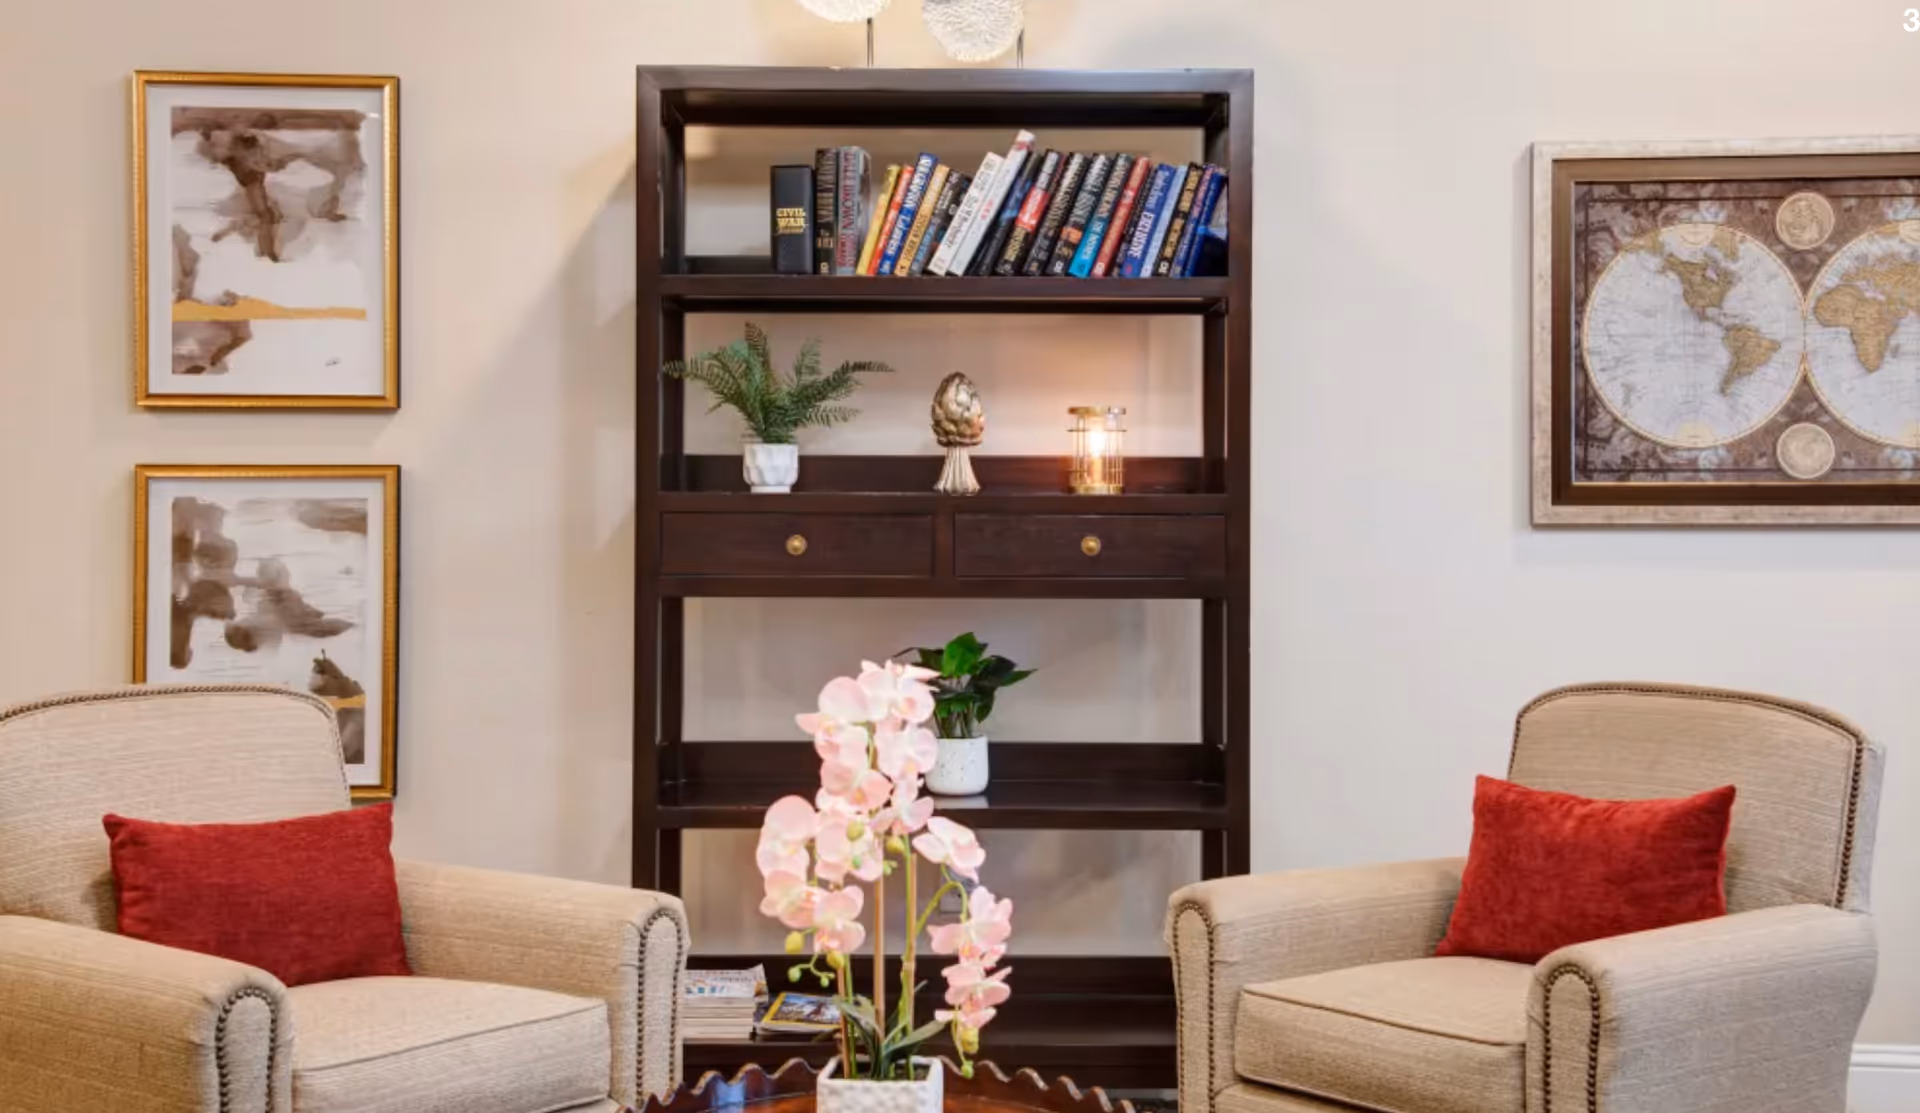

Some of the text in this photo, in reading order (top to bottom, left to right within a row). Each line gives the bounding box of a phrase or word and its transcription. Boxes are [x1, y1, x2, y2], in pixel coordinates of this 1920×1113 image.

[777, 208, 806, 217] CIVIL
[842, 184, 857, 229] BROWN
[778, 217, 808, 230] WAR
